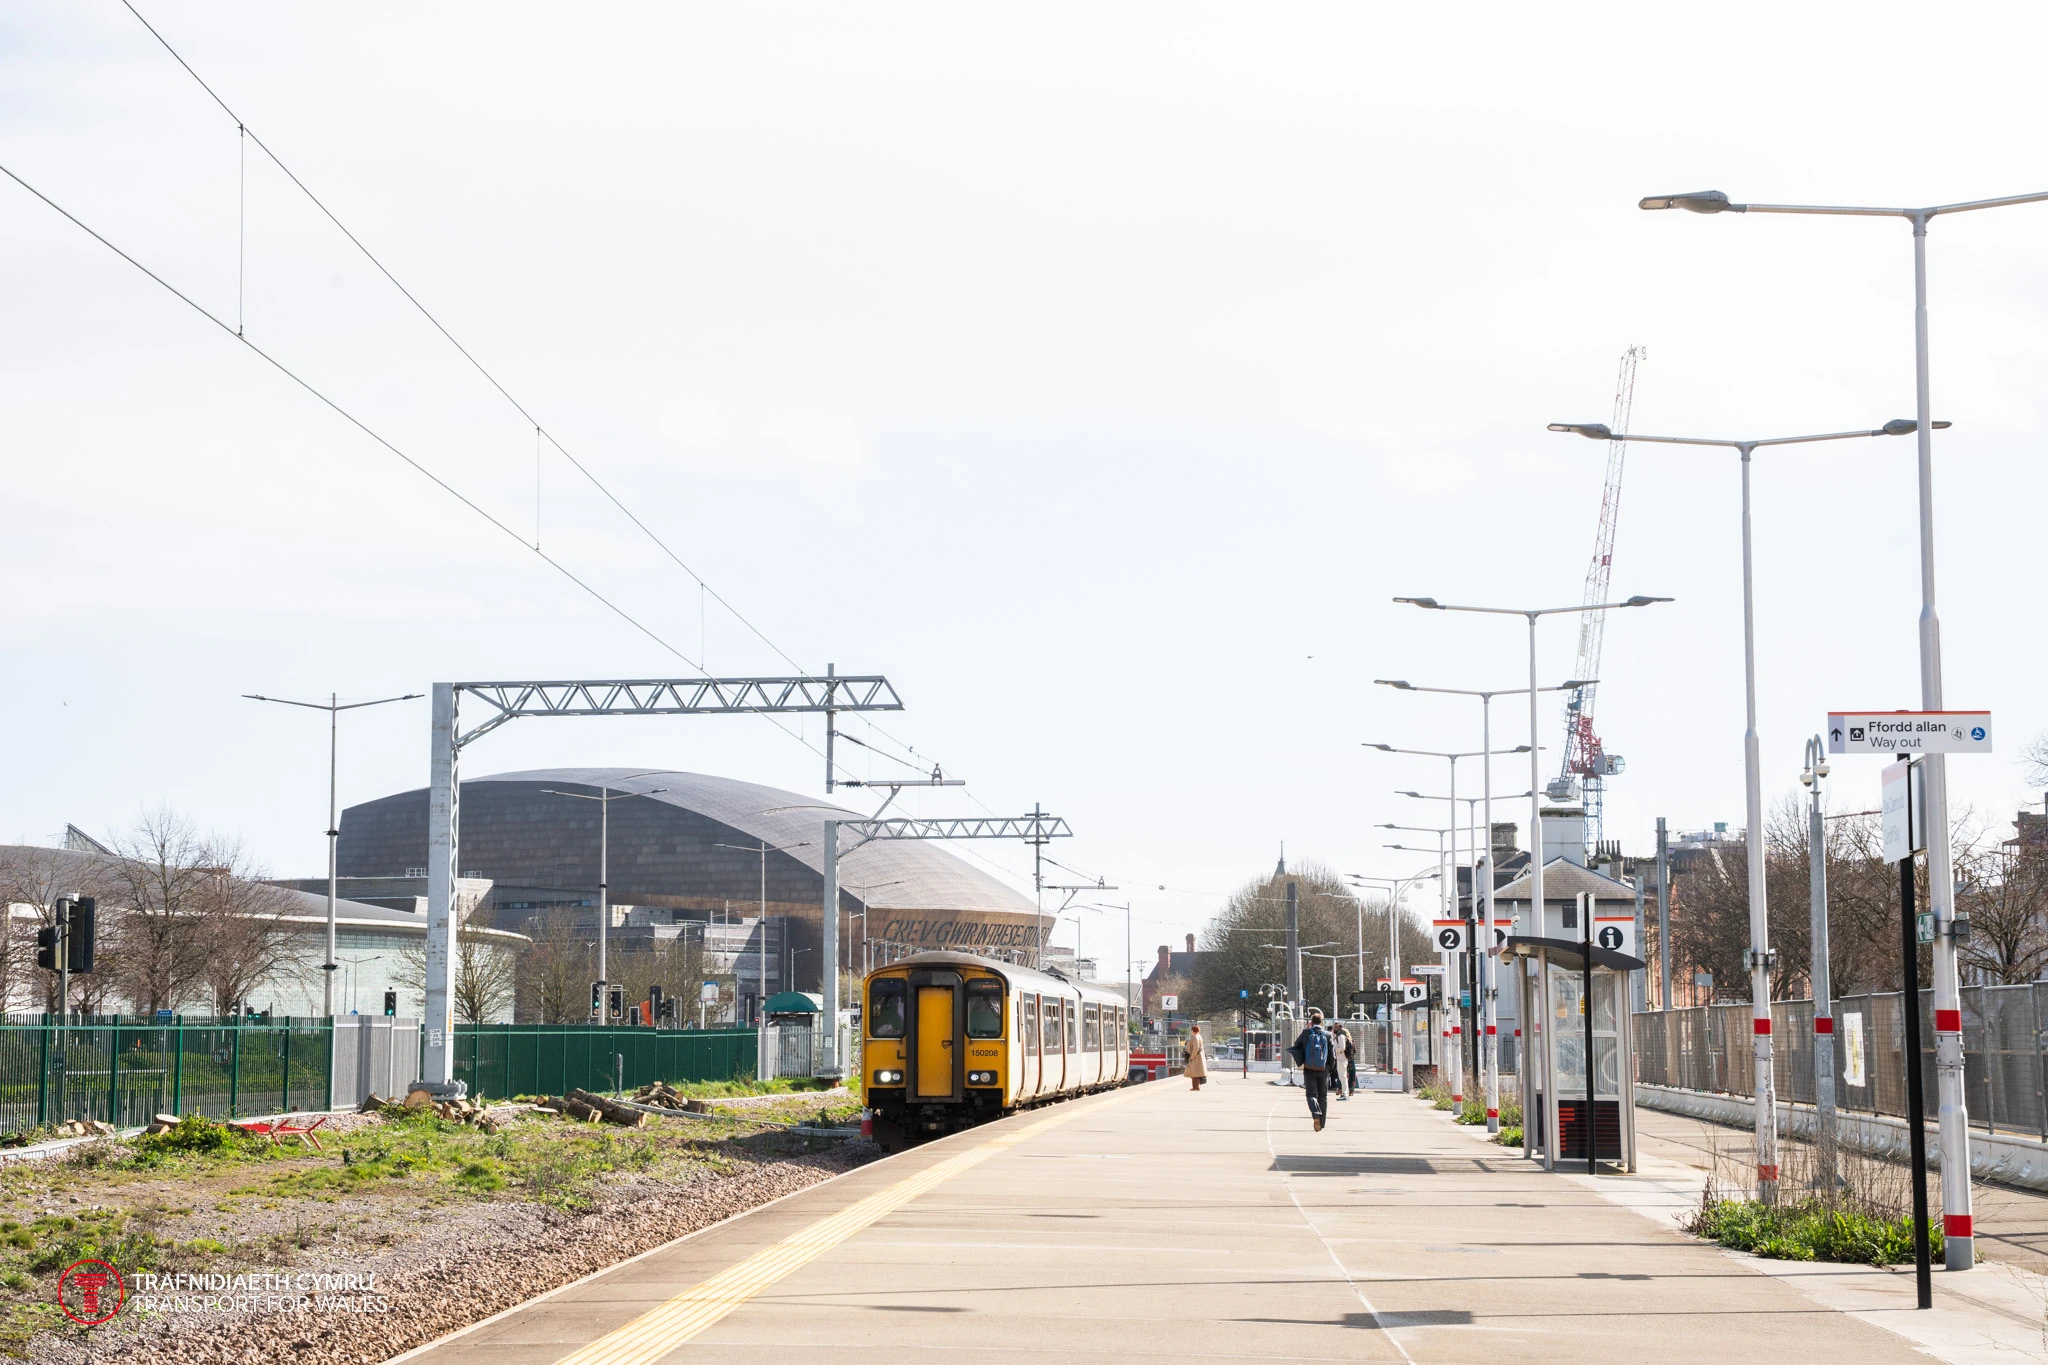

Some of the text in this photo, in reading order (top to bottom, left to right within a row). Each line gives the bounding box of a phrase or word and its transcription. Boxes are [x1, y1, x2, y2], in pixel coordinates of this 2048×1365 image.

[1868, 721, 1946, 732] Ffordd allan
[1869, 736, 1922, 750] Way out
[1444, 931, 1455, 947] 2
[971, 1049, 999, 1057] 150208
